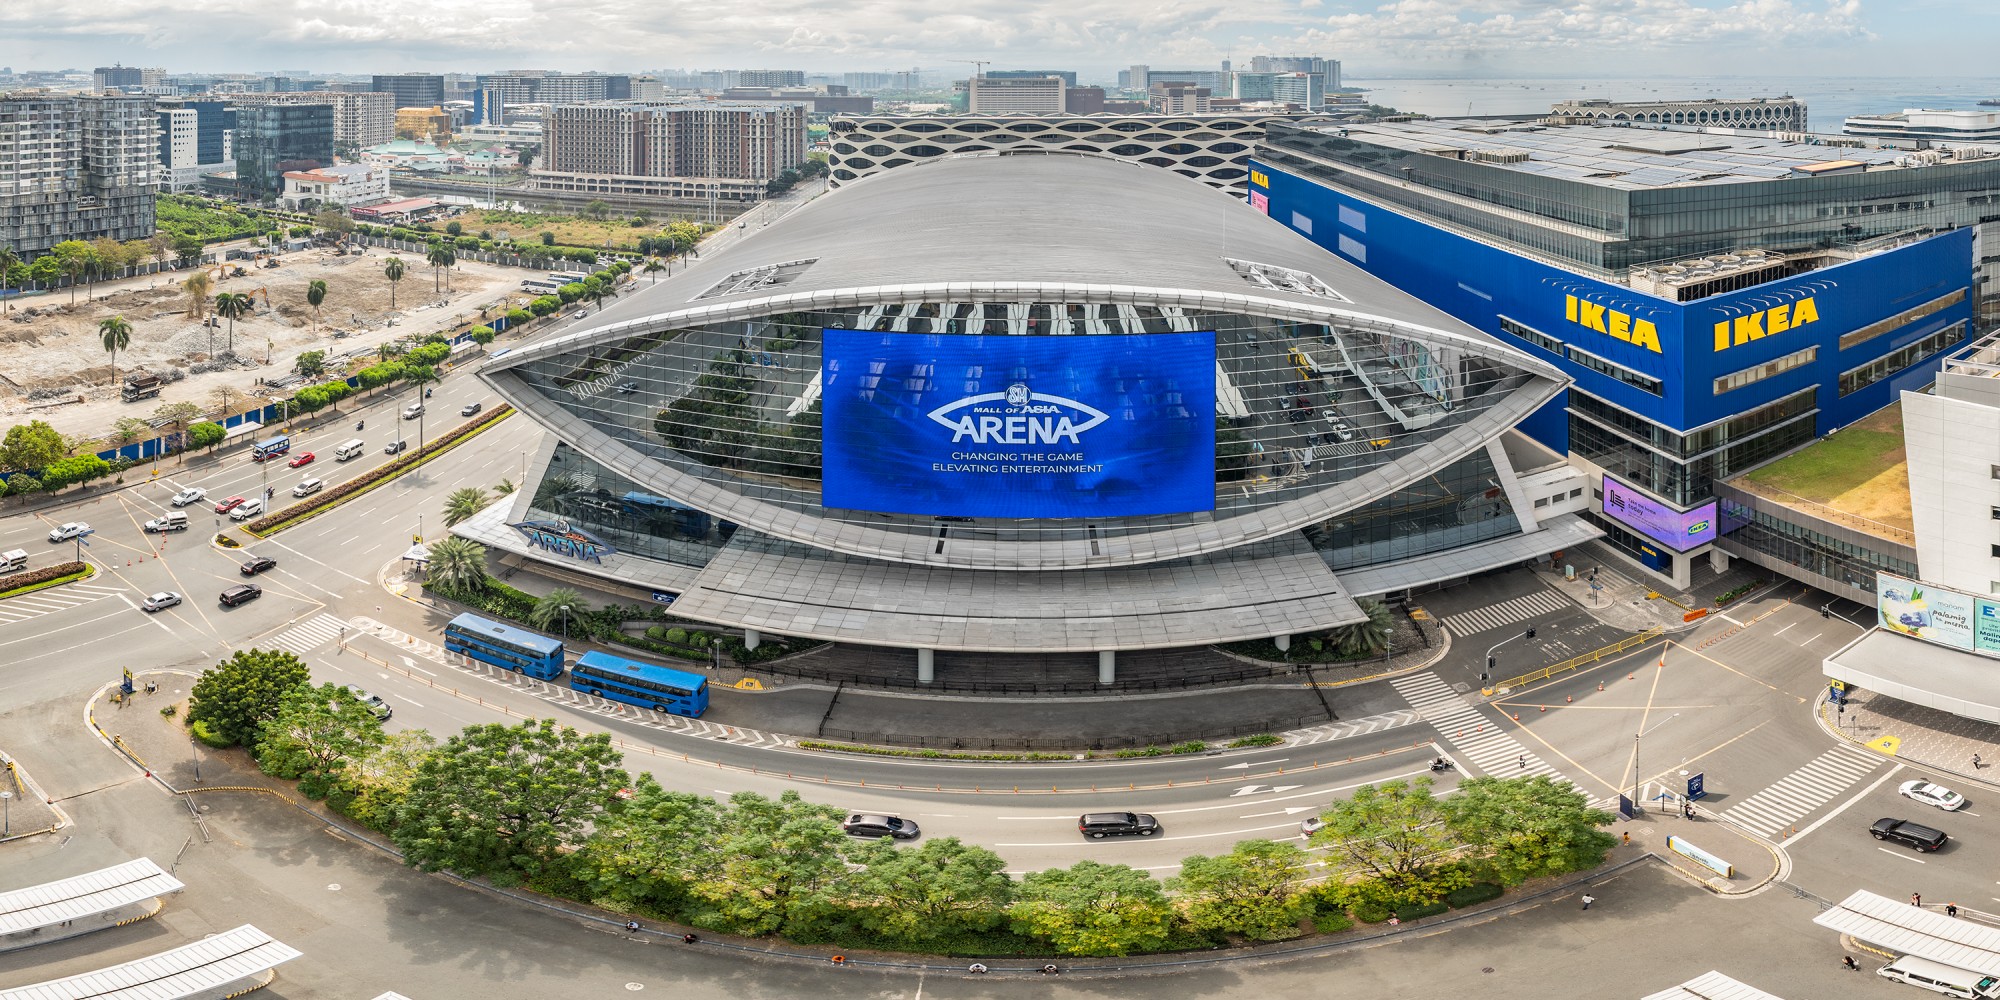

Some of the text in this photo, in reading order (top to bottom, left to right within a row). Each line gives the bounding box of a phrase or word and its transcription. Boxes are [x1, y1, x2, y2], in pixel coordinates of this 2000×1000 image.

[1251, 170, 1269, 189] IKEA
[1566, 294, 1662, 354] IKEA
[1714, 297, 1819, 352] IKEA
[1007, 388, 1027, 403] SM
[1020, 405, 1062, 414] ASIA
[952, 416, 1080, 444] ARENA
[951, 452, 1083, 461] CHANGING THE GAME
[932, 463, 1103, 474] ELEVATING ENTERTAINMENT
[1628, 503, 1644, 516] today
[527, 531, 601, 564] ARENA
[1932, 609, 1966, 624] palamig
